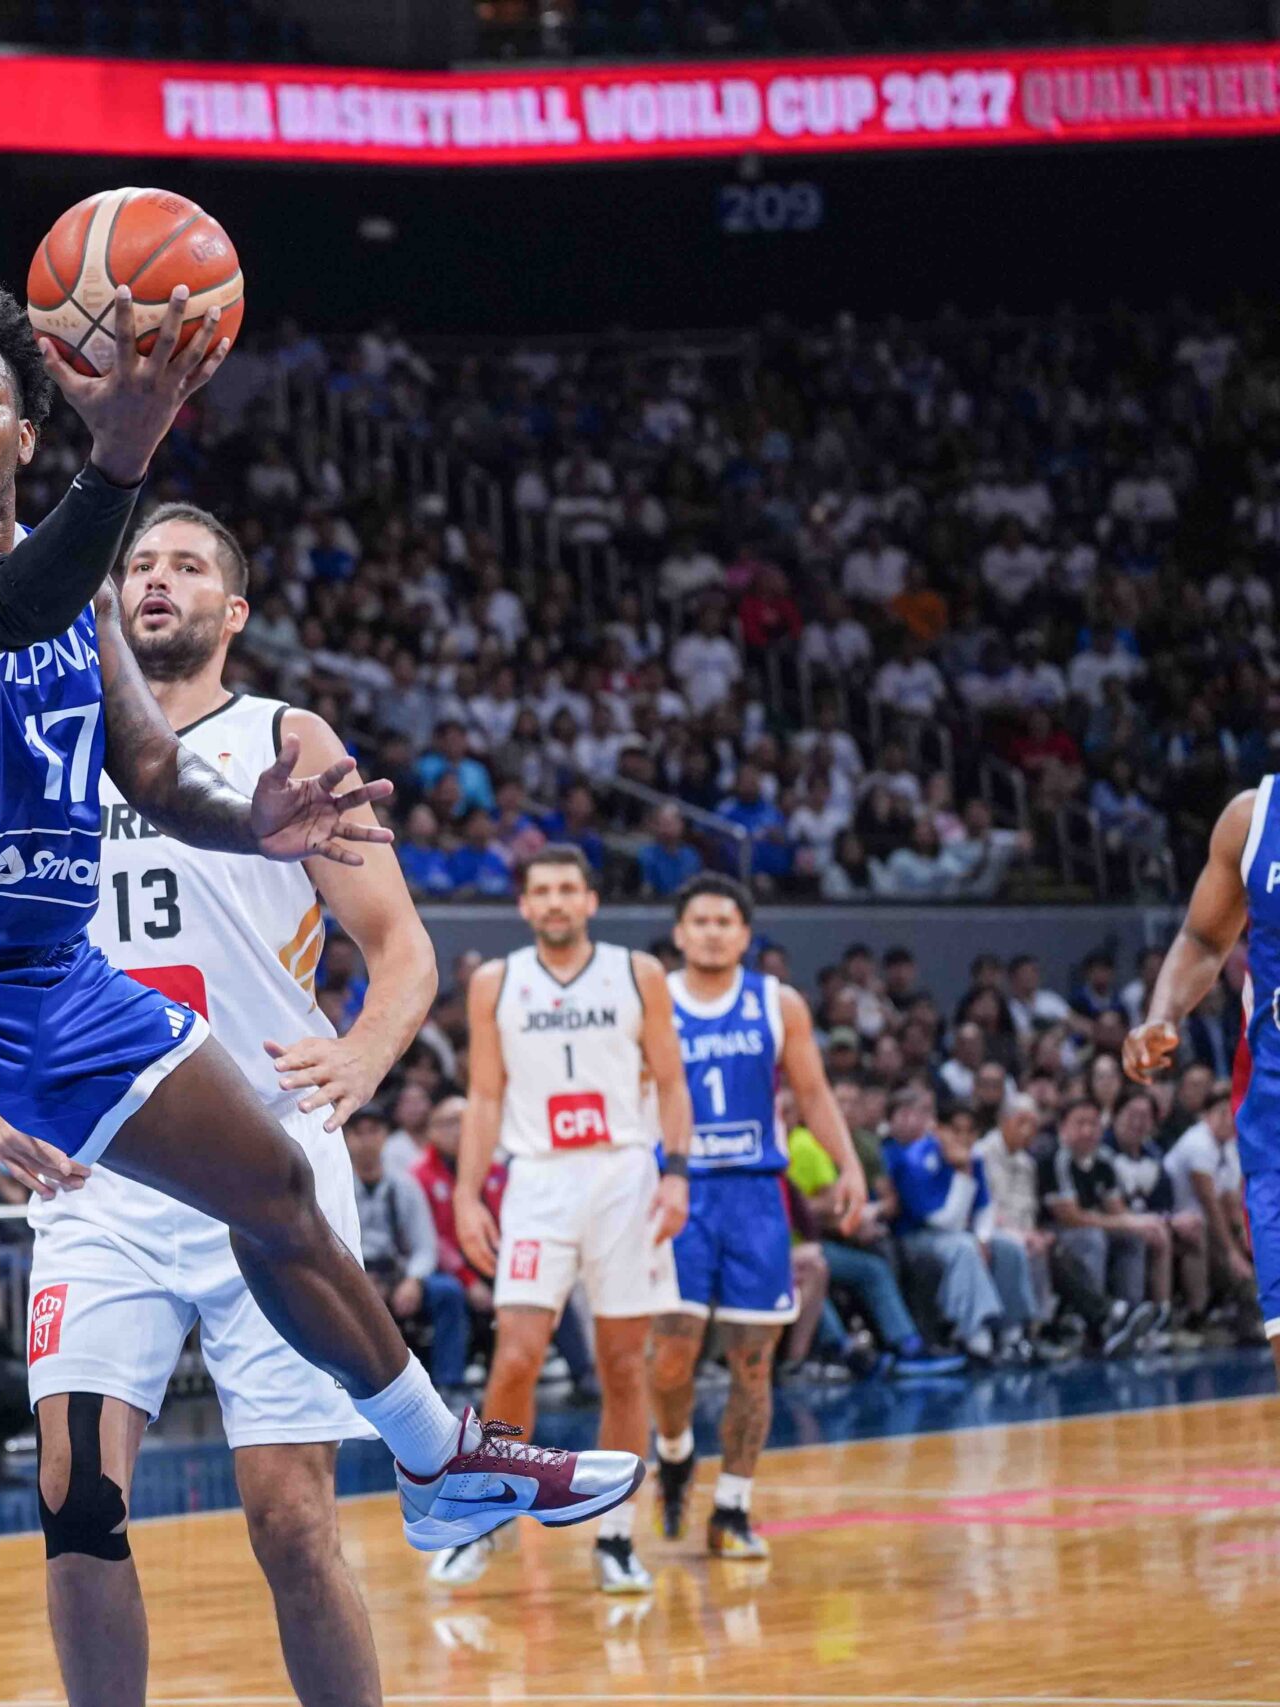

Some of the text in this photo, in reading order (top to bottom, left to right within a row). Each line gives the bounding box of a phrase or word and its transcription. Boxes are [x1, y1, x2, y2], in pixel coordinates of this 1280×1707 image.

[162, 62, 1280, 148] FIBA BASKETBALL WORLD CUP 2027 QUALIFIER
[723, 181, 820, 233] 209
[23, 701, 100, 803] 17
[112, 867, 182, 942] 13
[520, 1008, 617, 1034] JORDAN
[562, 1042, 574, 1081] 1
[702, 1066, 727, 1116] 1
[32, 1322, 51, 1354] RJ
